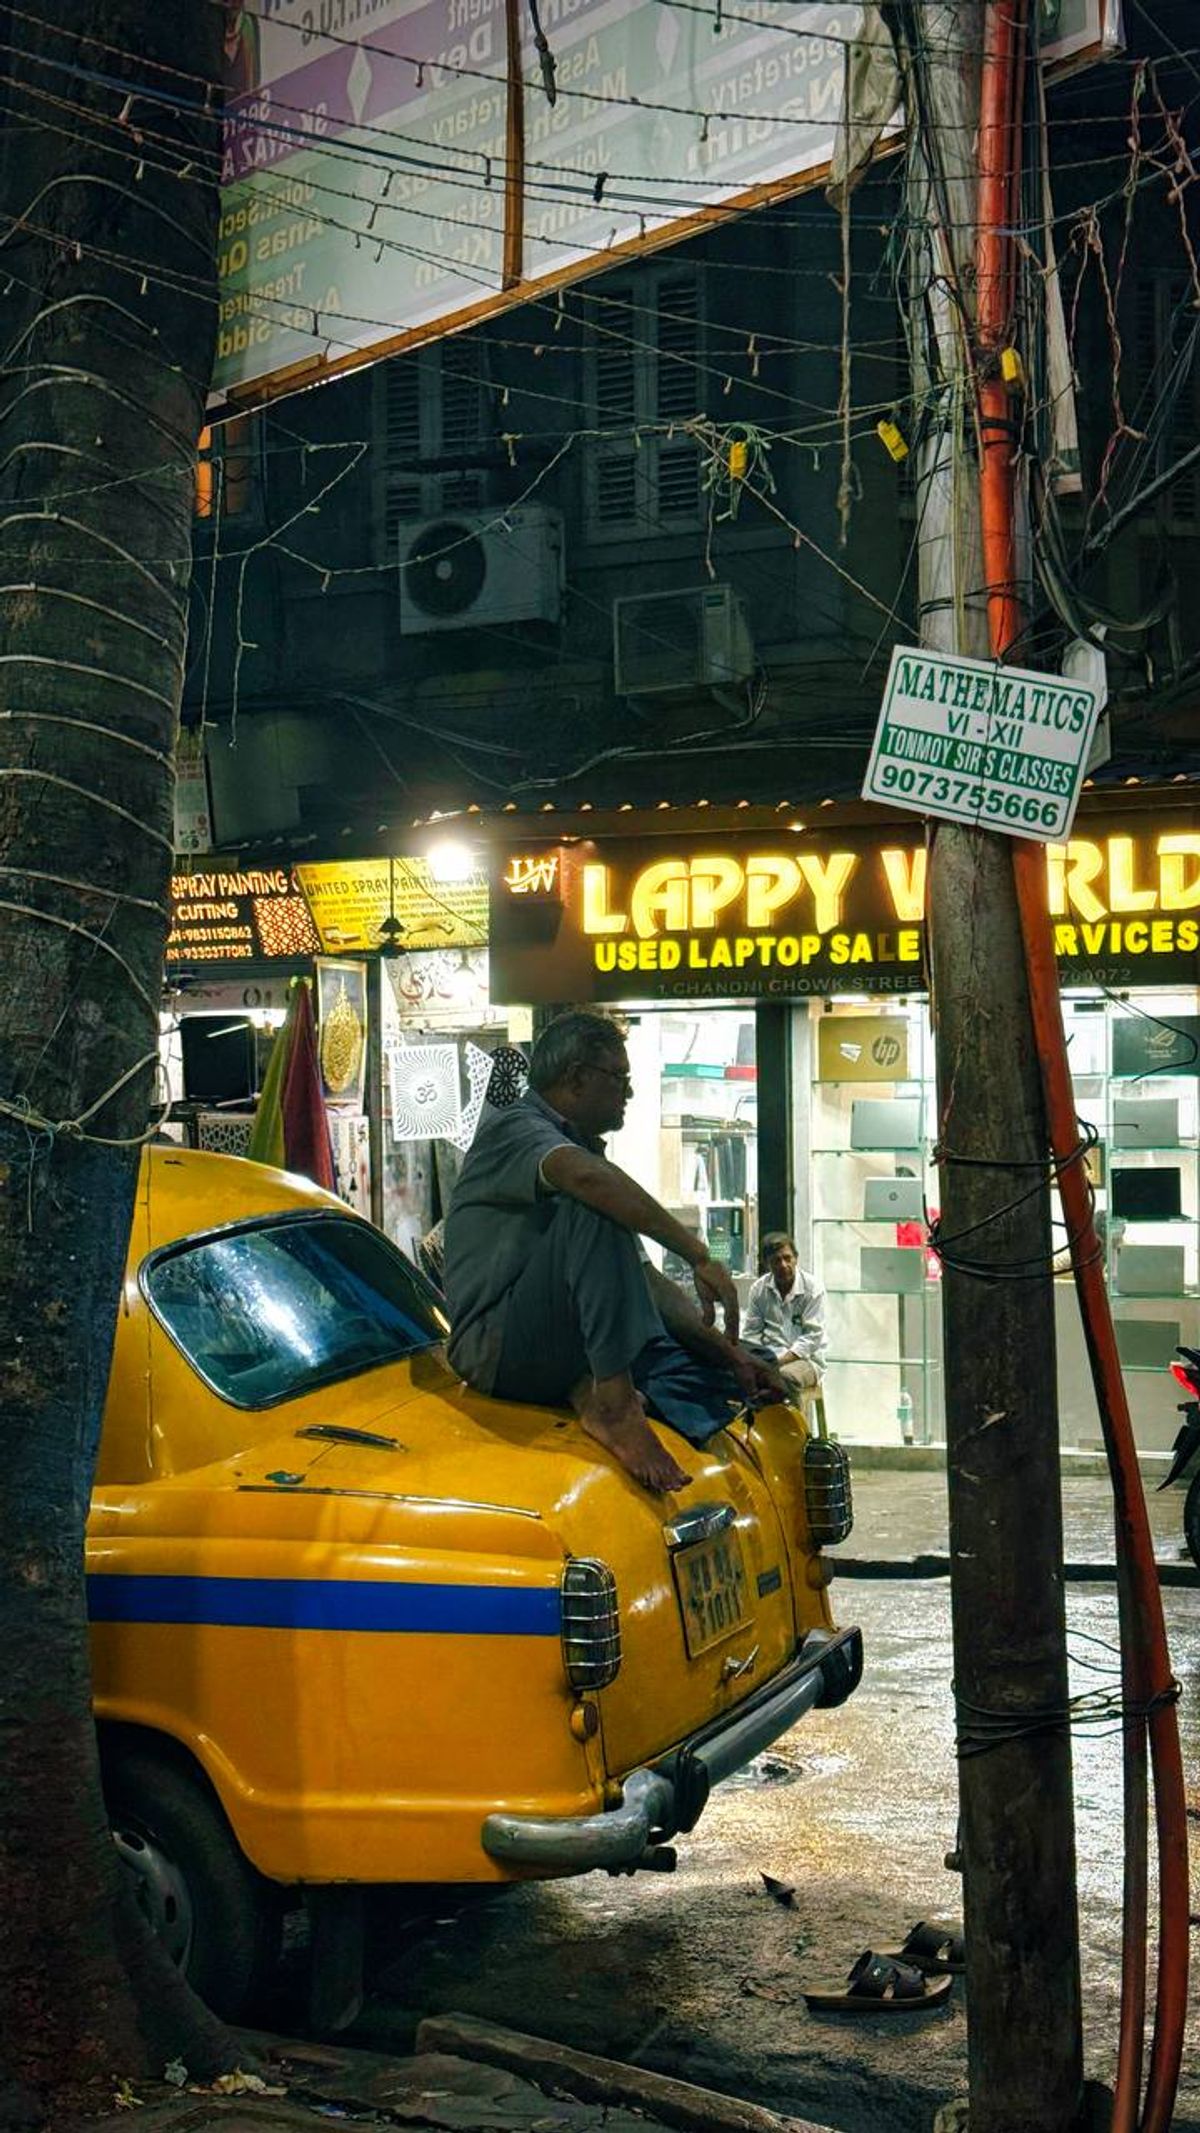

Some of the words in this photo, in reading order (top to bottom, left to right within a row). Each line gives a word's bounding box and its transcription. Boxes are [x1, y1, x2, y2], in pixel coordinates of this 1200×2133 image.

[897, 660, 1088, 733] MATHEMATICS
[948, 711, 970, 736] VI
[991, 720, 1024, 748] XII
[887, 726, 953, 765] TONMOY
[998, 752, 1073, 795] CLASSES
[880, 764, 1060, 827] 9073755666
[218, 870, 289, 897] PAINTING
[352, 877, 389, 894] SPRAY
[582, 852, 858, 939] LAPPY
[177, 902, 239, 921] CUTTING
[595, 940, 681, 972] USED
[689, 934, 821, 970] LAPTOP
[830, 930, 920, 965] SALE
[1054, 920, 1199, 956] RVICES
[768, 978, 845, 993] CHOWK
[852, 975, 921, 990] STREE
